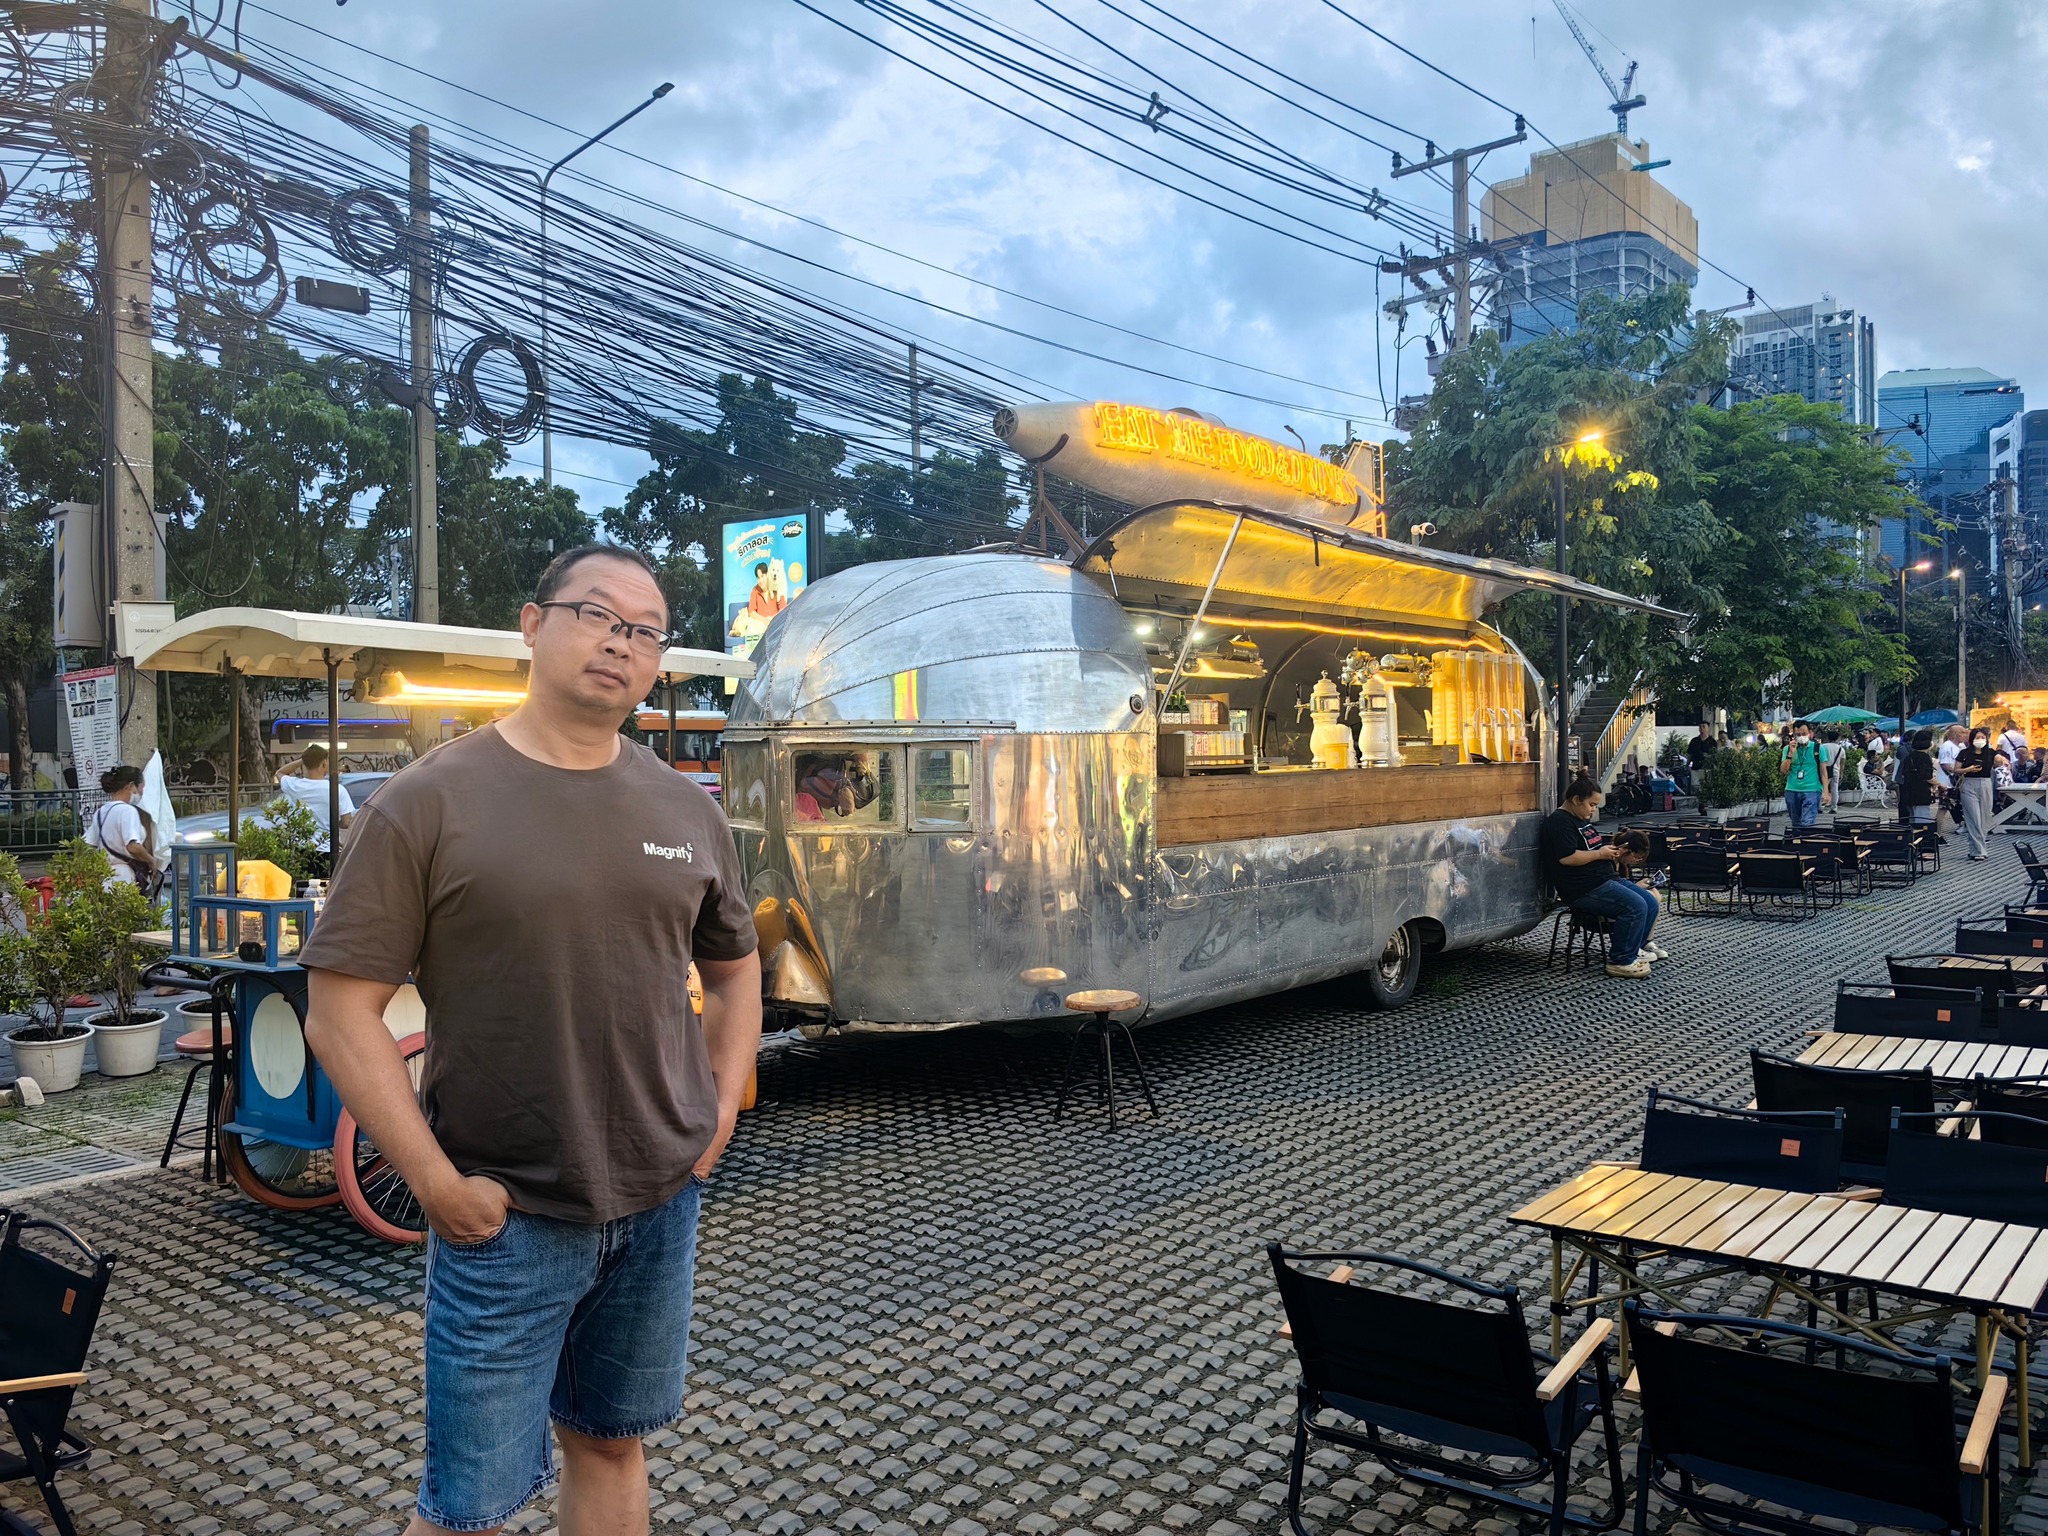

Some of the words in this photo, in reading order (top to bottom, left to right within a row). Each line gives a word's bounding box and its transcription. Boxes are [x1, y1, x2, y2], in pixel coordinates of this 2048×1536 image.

[1095, 402, 1160, 450] EAT
[1165, 413, 1214, 461] ME
[643, 842, 692, 863] Magnify
